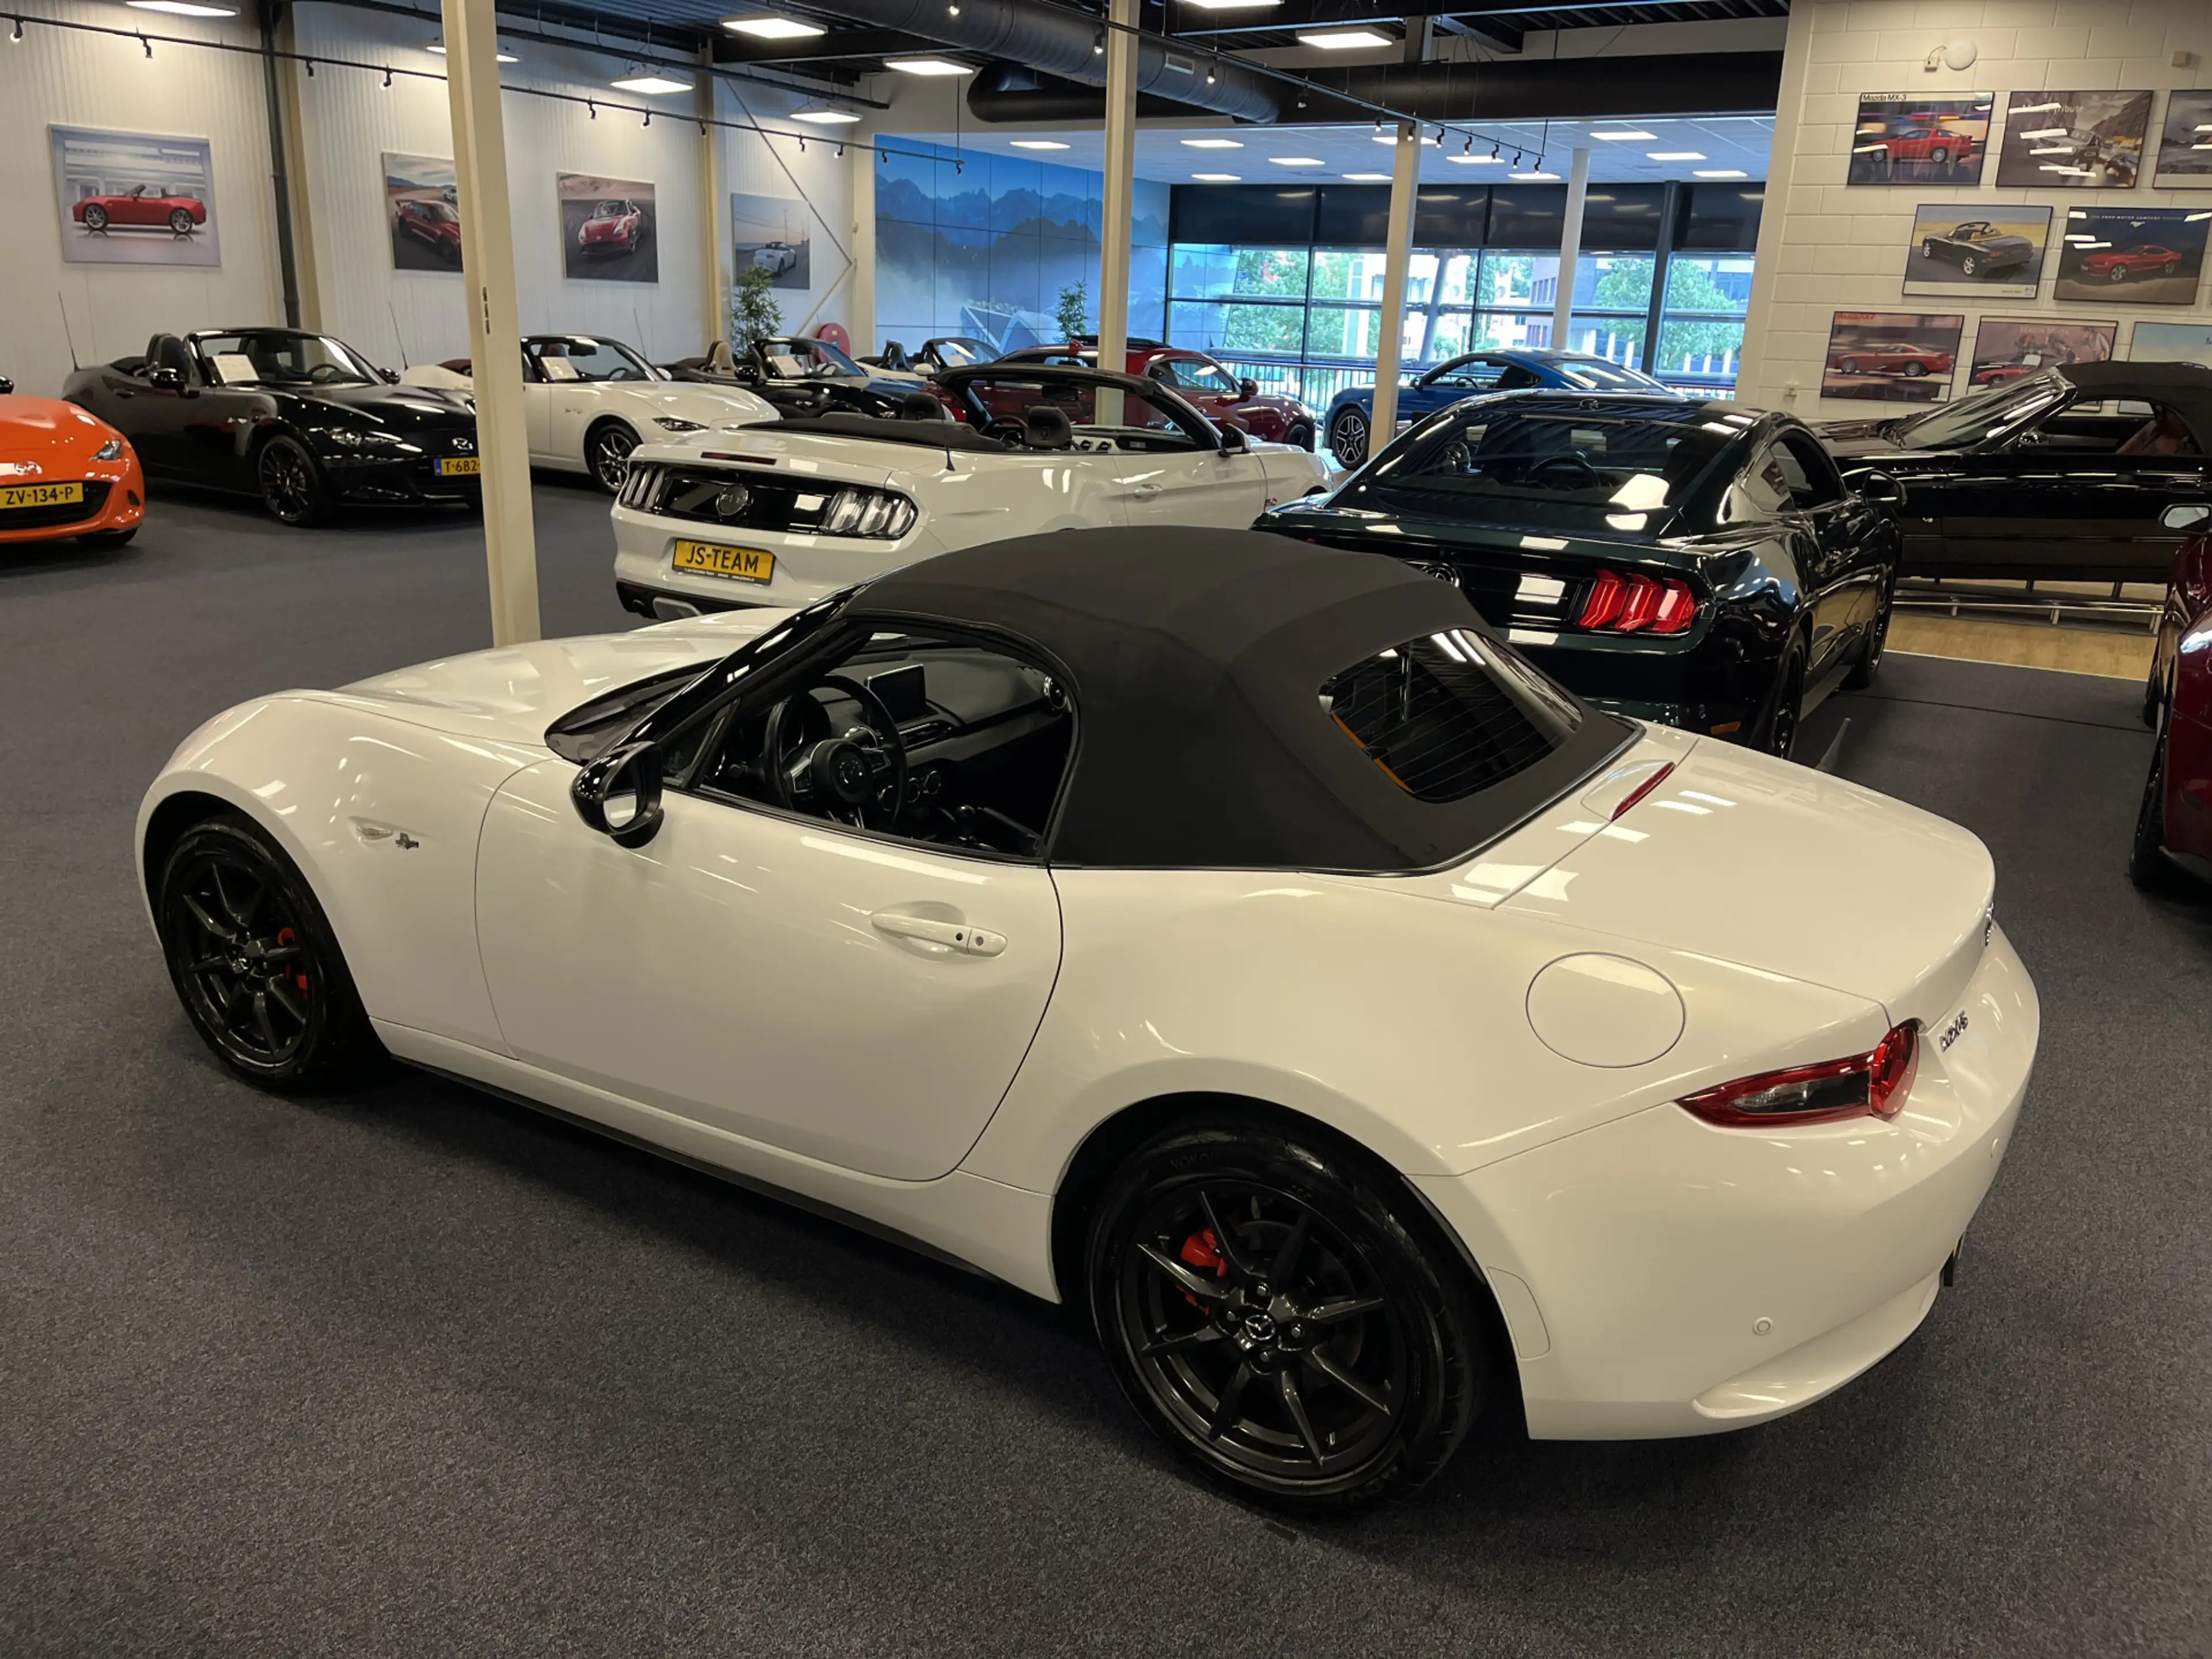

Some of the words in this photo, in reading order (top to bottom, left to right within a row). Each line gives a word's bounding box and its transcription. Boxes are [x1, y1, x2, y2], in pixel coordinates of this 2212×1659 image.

[1862, 93, 1887, 101] Mazda
[1887, 93, 1907, 101] MX-3
[5, 486, 74, 506] ZV-134-P
[685, 545, 760, 574] JS-TEAM
